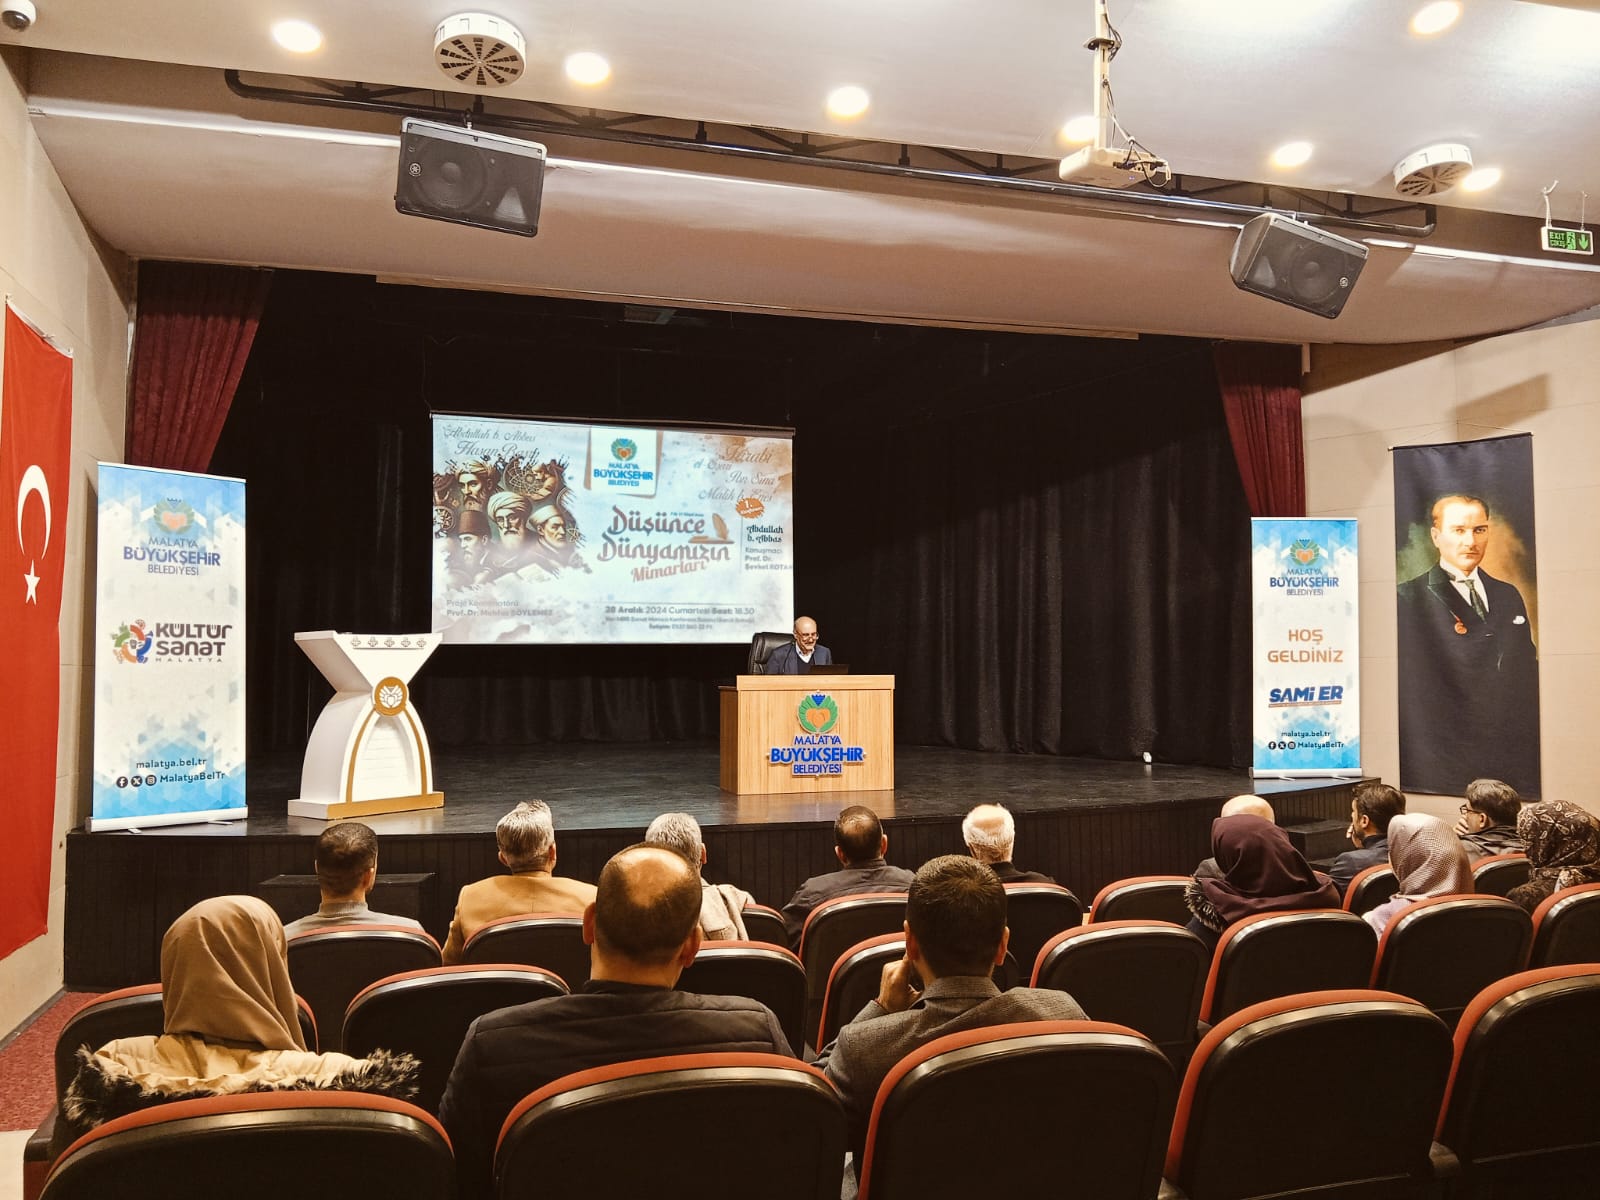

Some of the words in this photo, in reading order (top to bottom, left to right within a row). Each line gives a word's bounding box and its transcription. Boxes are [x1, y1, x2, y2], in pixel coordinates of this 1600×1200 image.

[1549, 231, 1565, 240] EXIT
[607, 505, 705, 536] Düşünce
[746, 524, 784, 534] Abdullah
[148, 537, 199, 548] MALATYA
[756, 535, 782, 544] Abbas
[597, 532, 731, 565] Dünyamızın
[631, 560, 707, 582] Mimarları
[646, 606, 667, 614] 2024
[1288, 629, 1324, 645] HOŞ
[1267, 647, 1344, 663] GELDİNİZ
[1318, 685, 1344, 700] ER
[1281, 730, 1331, 738] malatya.bel.tr
[794, 735, 842, 745] MALATYA
[1297, 741, 1345, 750] MalatyaBelTr
[136, 758, 207, 770] malatya.bel.tr
[159, 771, 226, 784] MalatyaBelTr
